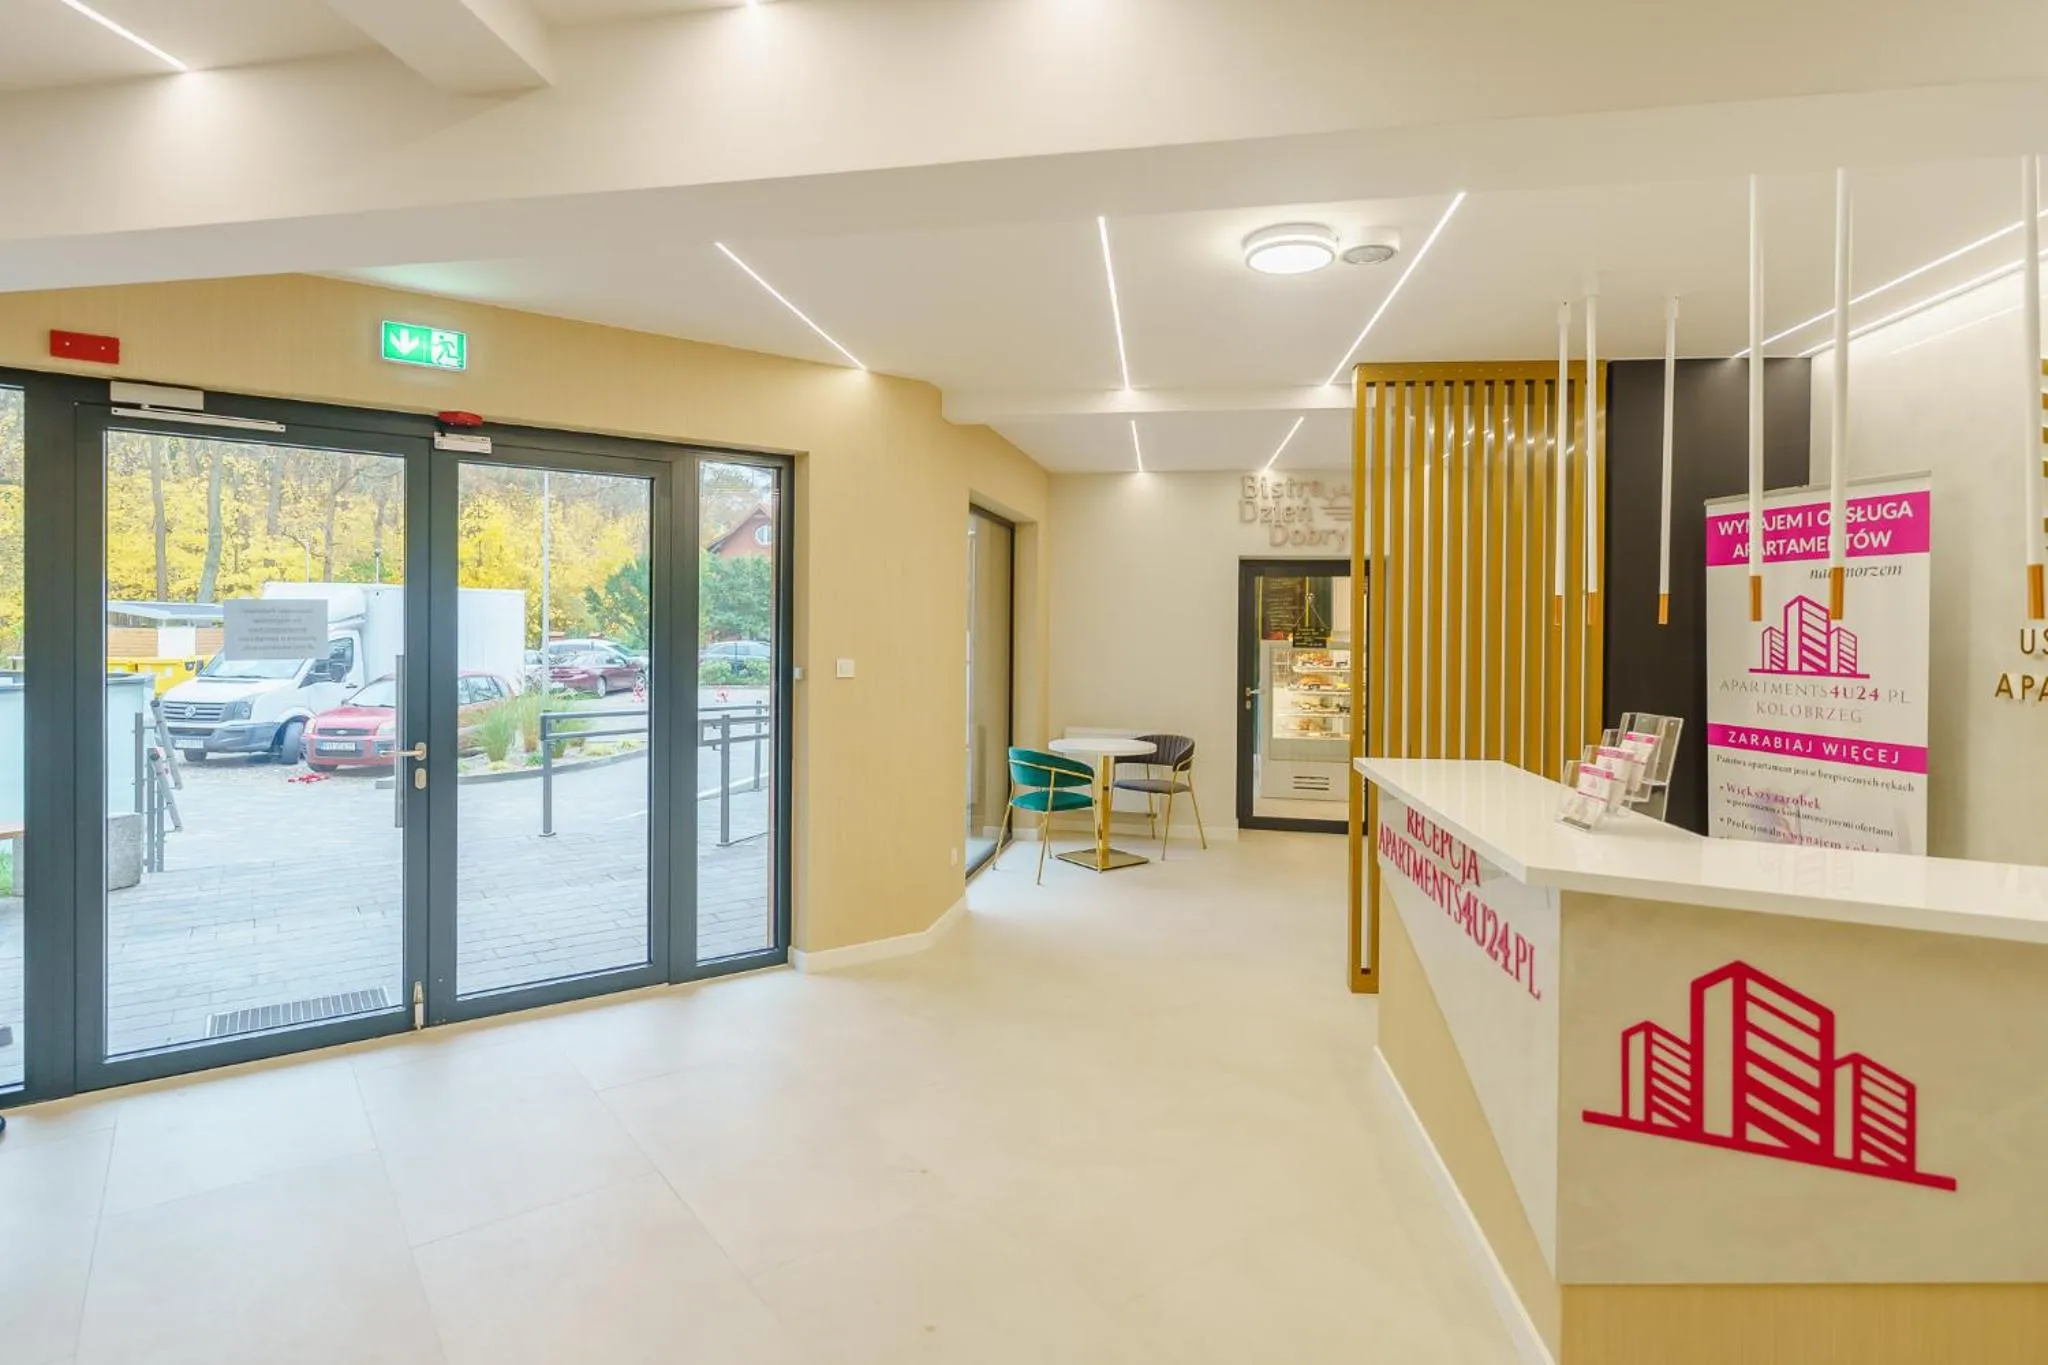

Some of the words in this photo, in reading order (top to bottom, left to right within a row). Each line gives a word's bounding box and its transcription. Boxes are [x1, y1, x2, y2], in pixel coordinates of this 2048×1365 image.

[1241, 475, 1324, 499] Bistro
[1239, 497, 1313, 524] Dzień
[1718, 512, 1803, 536] WYAJEM
[1807, 511, 1812, 527] I
[1817, 500, 1914, 526] OSŁUGA
[1269, 524, 1348, 552] Dobry
[1728, 731, 1813, 754] ZARABIAJ
[1822, 741, 1900, 765] WIĘCEJ
[1406, 805, 1481, 888] RECEPCJA
